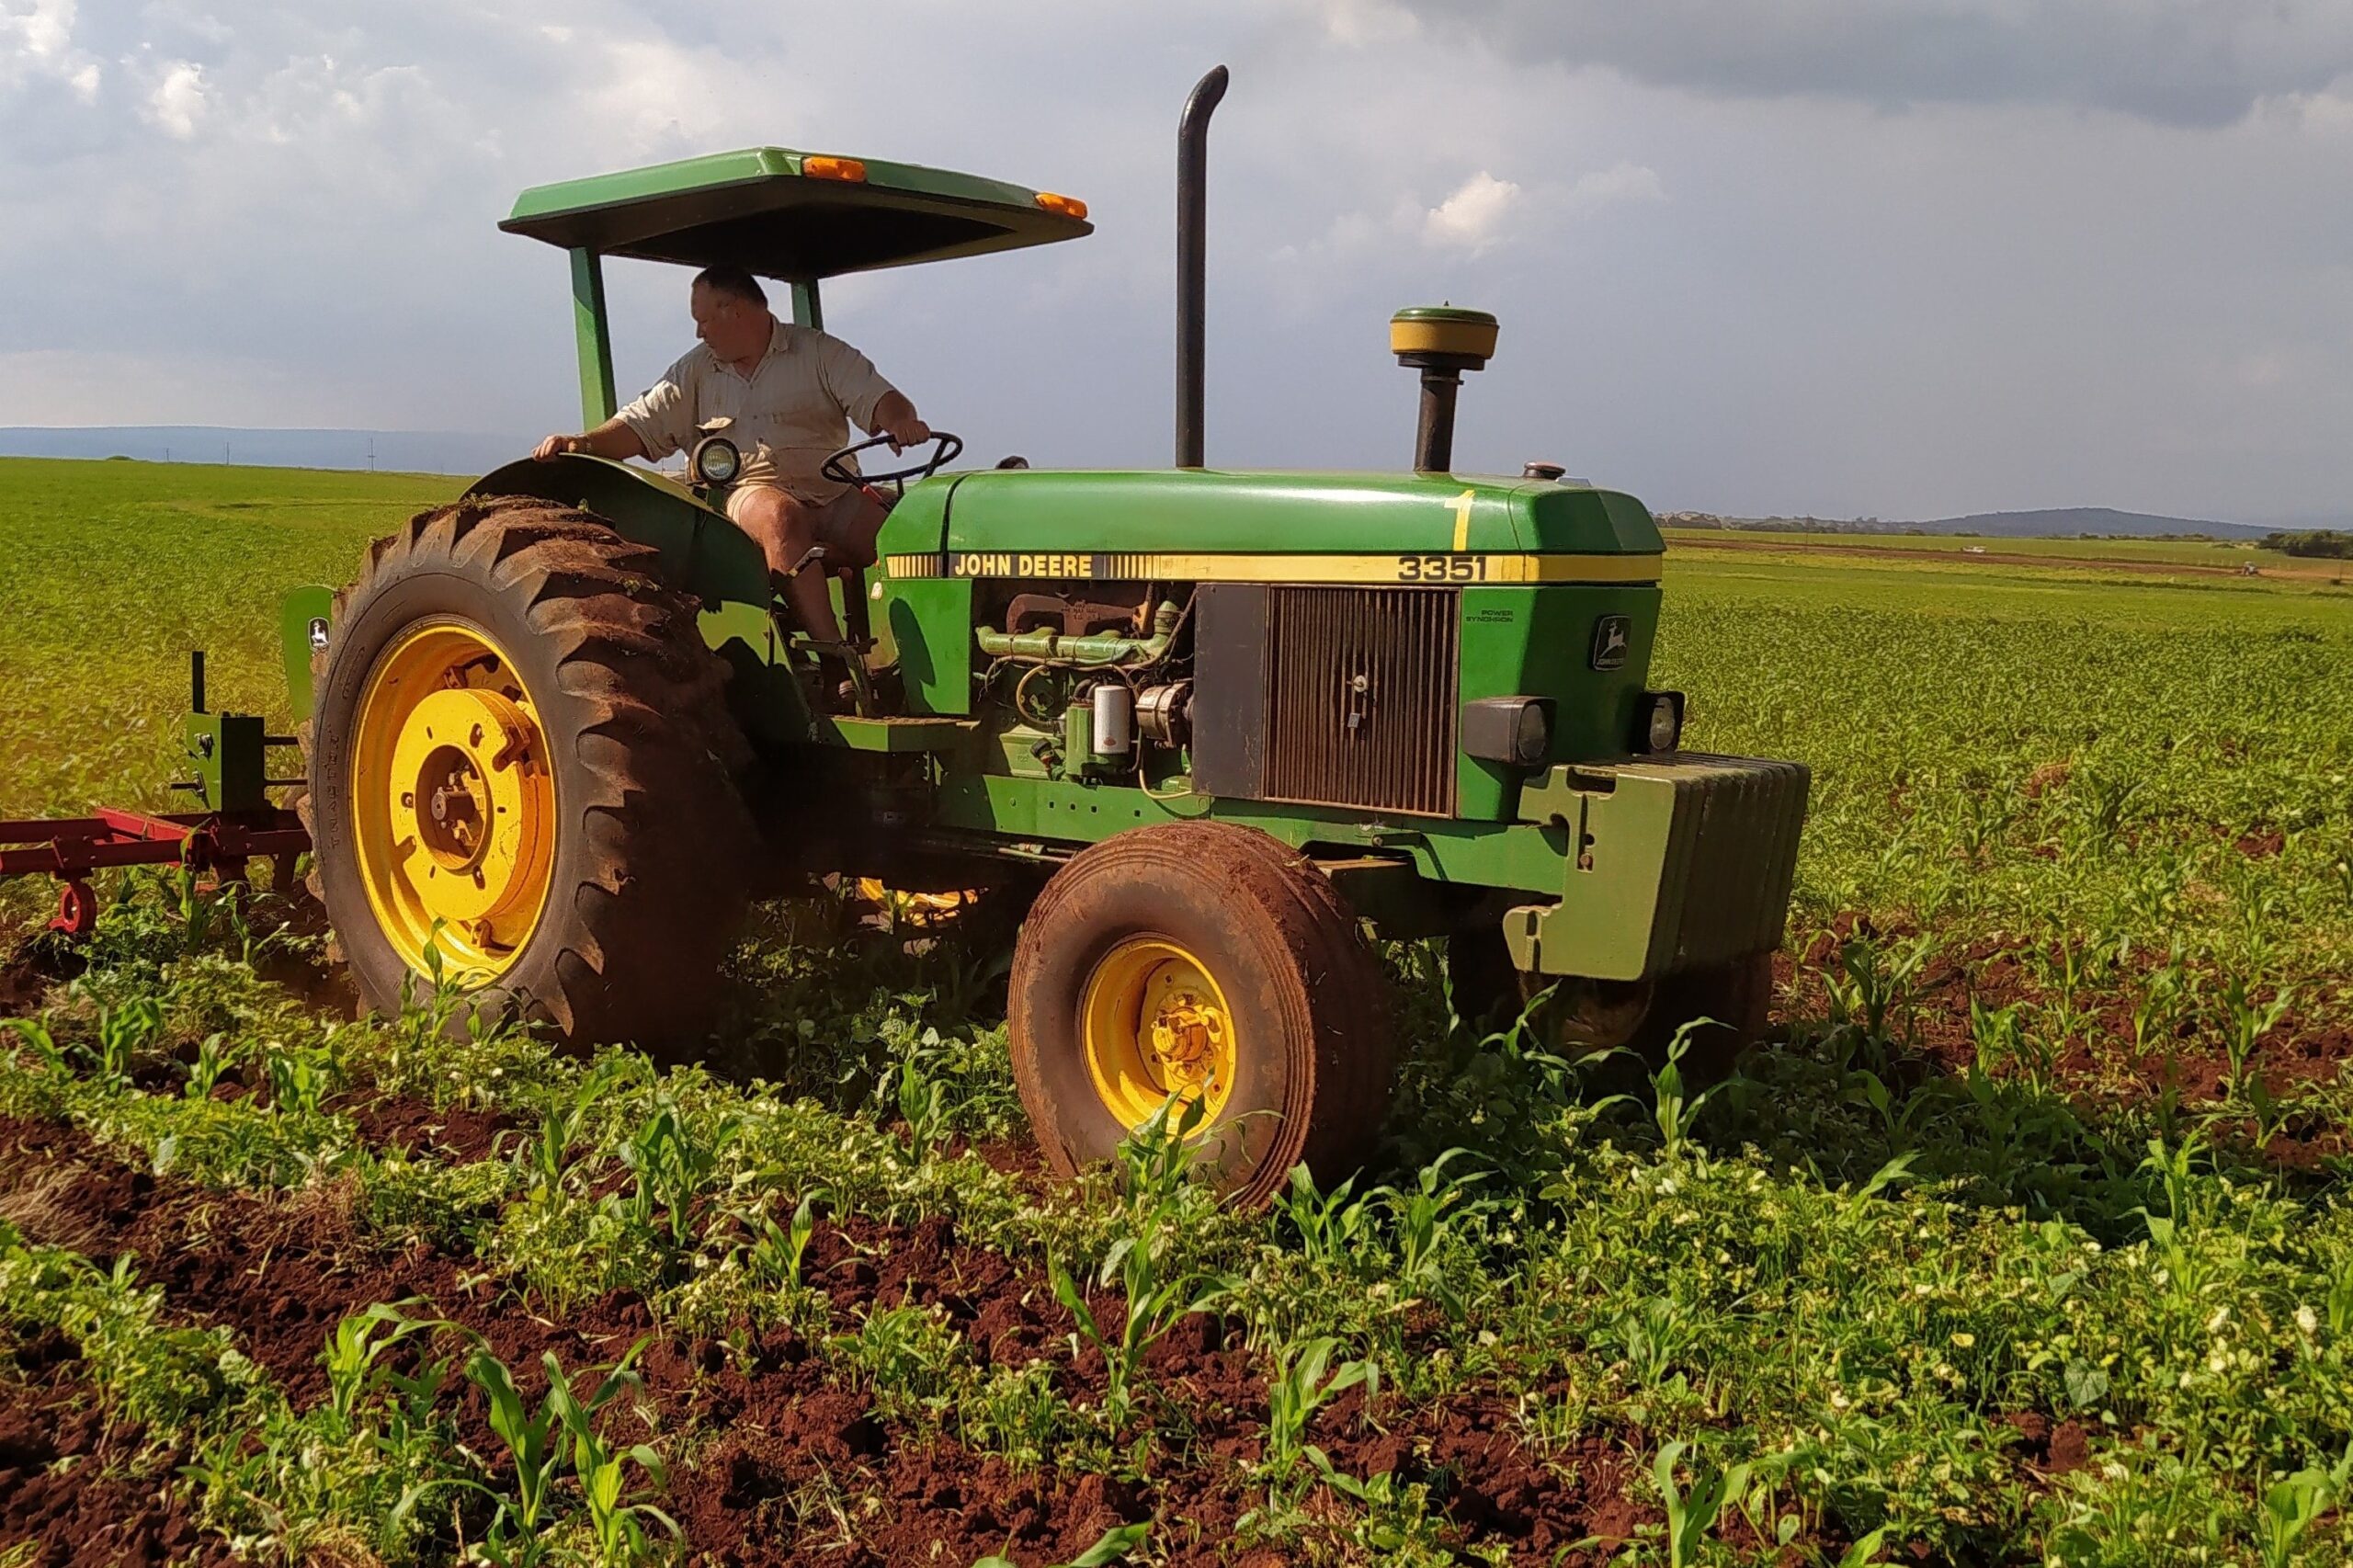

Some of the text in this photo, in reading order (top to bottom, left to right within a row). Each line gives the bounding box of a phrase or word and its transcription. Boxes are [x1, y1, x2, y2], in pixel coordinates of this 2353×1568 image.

[1443, 489, 1475, 551] 1
[954, 553, 1093, 577] JOHN DEERE
[1398, 556, 1486, 581] 3351
